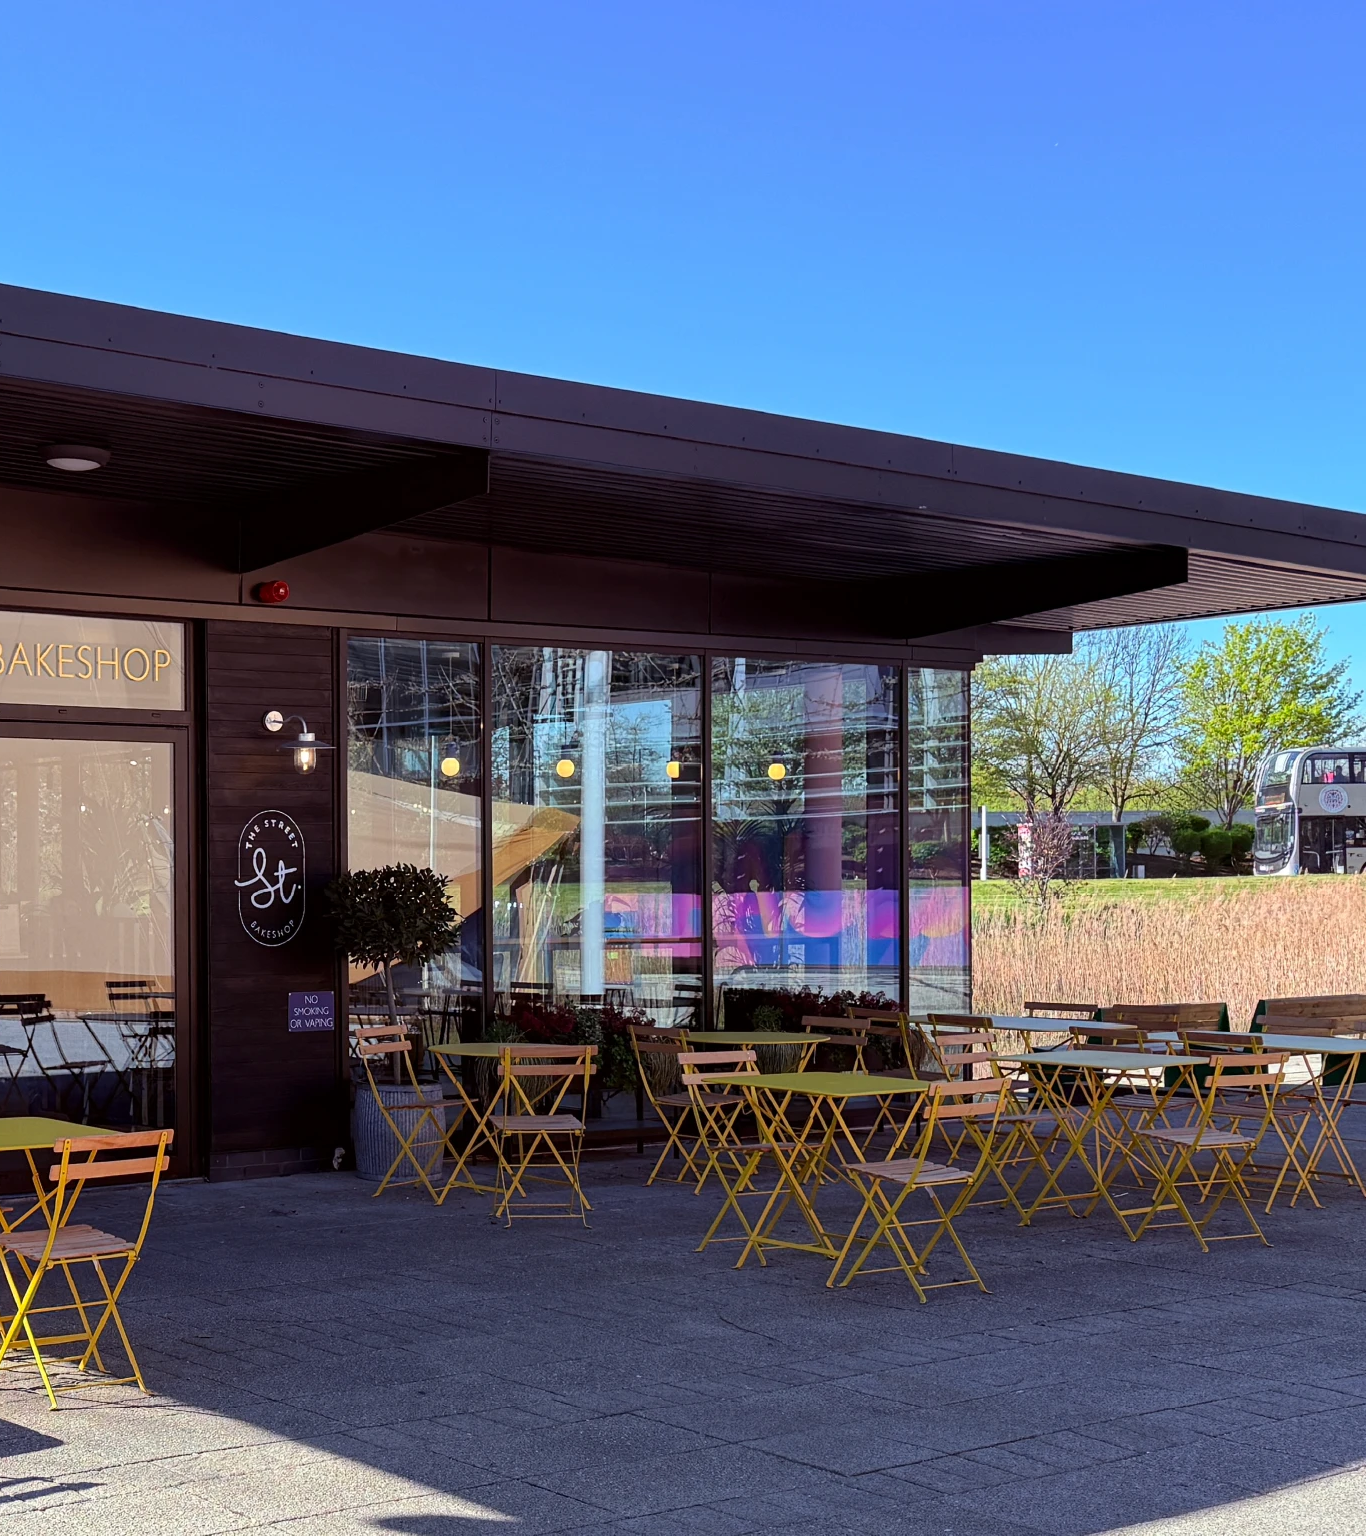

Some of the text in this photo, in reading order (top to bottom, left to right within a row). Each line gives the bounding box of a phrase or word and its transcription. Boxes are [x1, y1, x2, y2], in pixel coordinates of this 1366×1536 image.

[245, 819, 299, 849] THE STREET
[250, 919, 295, 939] BAKESHOP
[304, 995, 319, 1004] NO
[294, 1006, 329, 1016] SMOKING
[290, 1017, 333, 1028] OR VAPING
